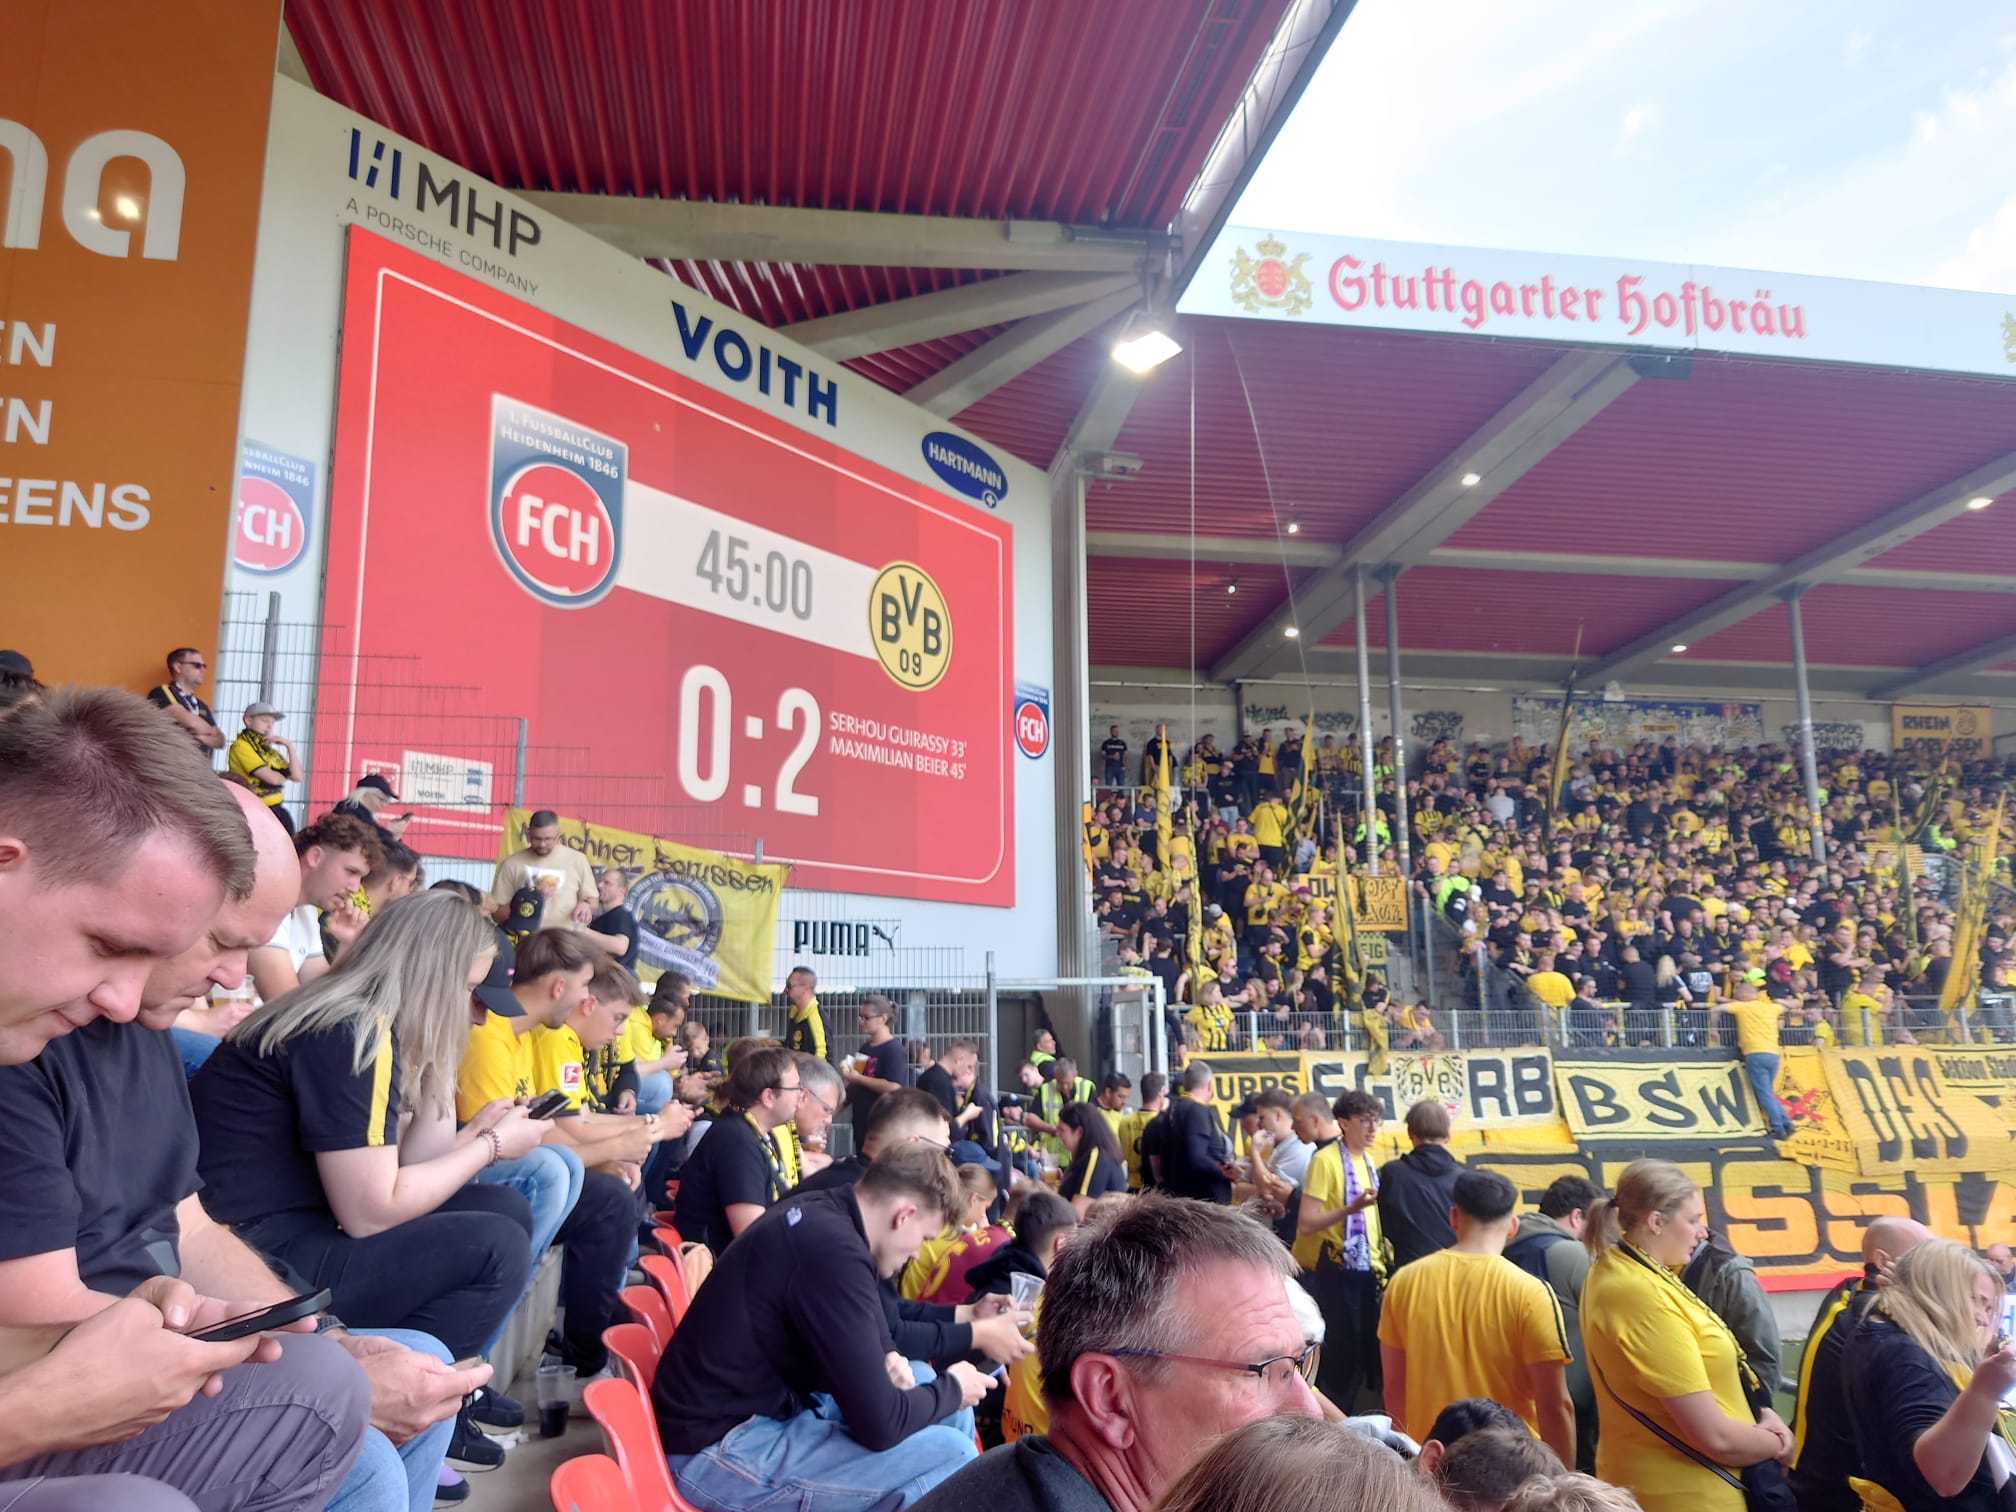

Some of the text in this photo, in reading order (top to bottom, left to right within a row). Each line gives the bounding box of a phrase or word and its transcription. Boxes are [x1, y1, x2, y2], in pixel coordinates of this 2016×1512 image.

[416, 162, 541, 256] MHP
[345, 197, 539, 297] A PORSCHE COMPANY
[1328, 253, 1807, 339] Stuttgarter Hofbräu
[0, 321, 56, 368] N
[671, 300, 838, 428] VOITH
[0, 397, 53, 445] N
[588, 456, 619, 479] 1846
[928, 441, 1002, 491] HARTMANN
[238, 500, 293, 550] CH
[516, 493, 600, 567] FCH
[696, 528, 814, 621] 45:00
[881, 574, 942, 657] BVB
[899, 648, 922, 677] 09
[678, 664, 821, 817] 0:2
[830, 711, 968, 758] SERHOU GUIRASSY 33'
[830, 736, 967, 780] MAXIMILIAN BEIER 45'
[1020, 715, 1045, 743] FCH
[794, 920, 870, 957] PUMA
[1467, 1055, 1553, 1119] RB
[1568, 1059, 1753, 1129] BSW
[1842, 1056, 1968, 1163] DES
